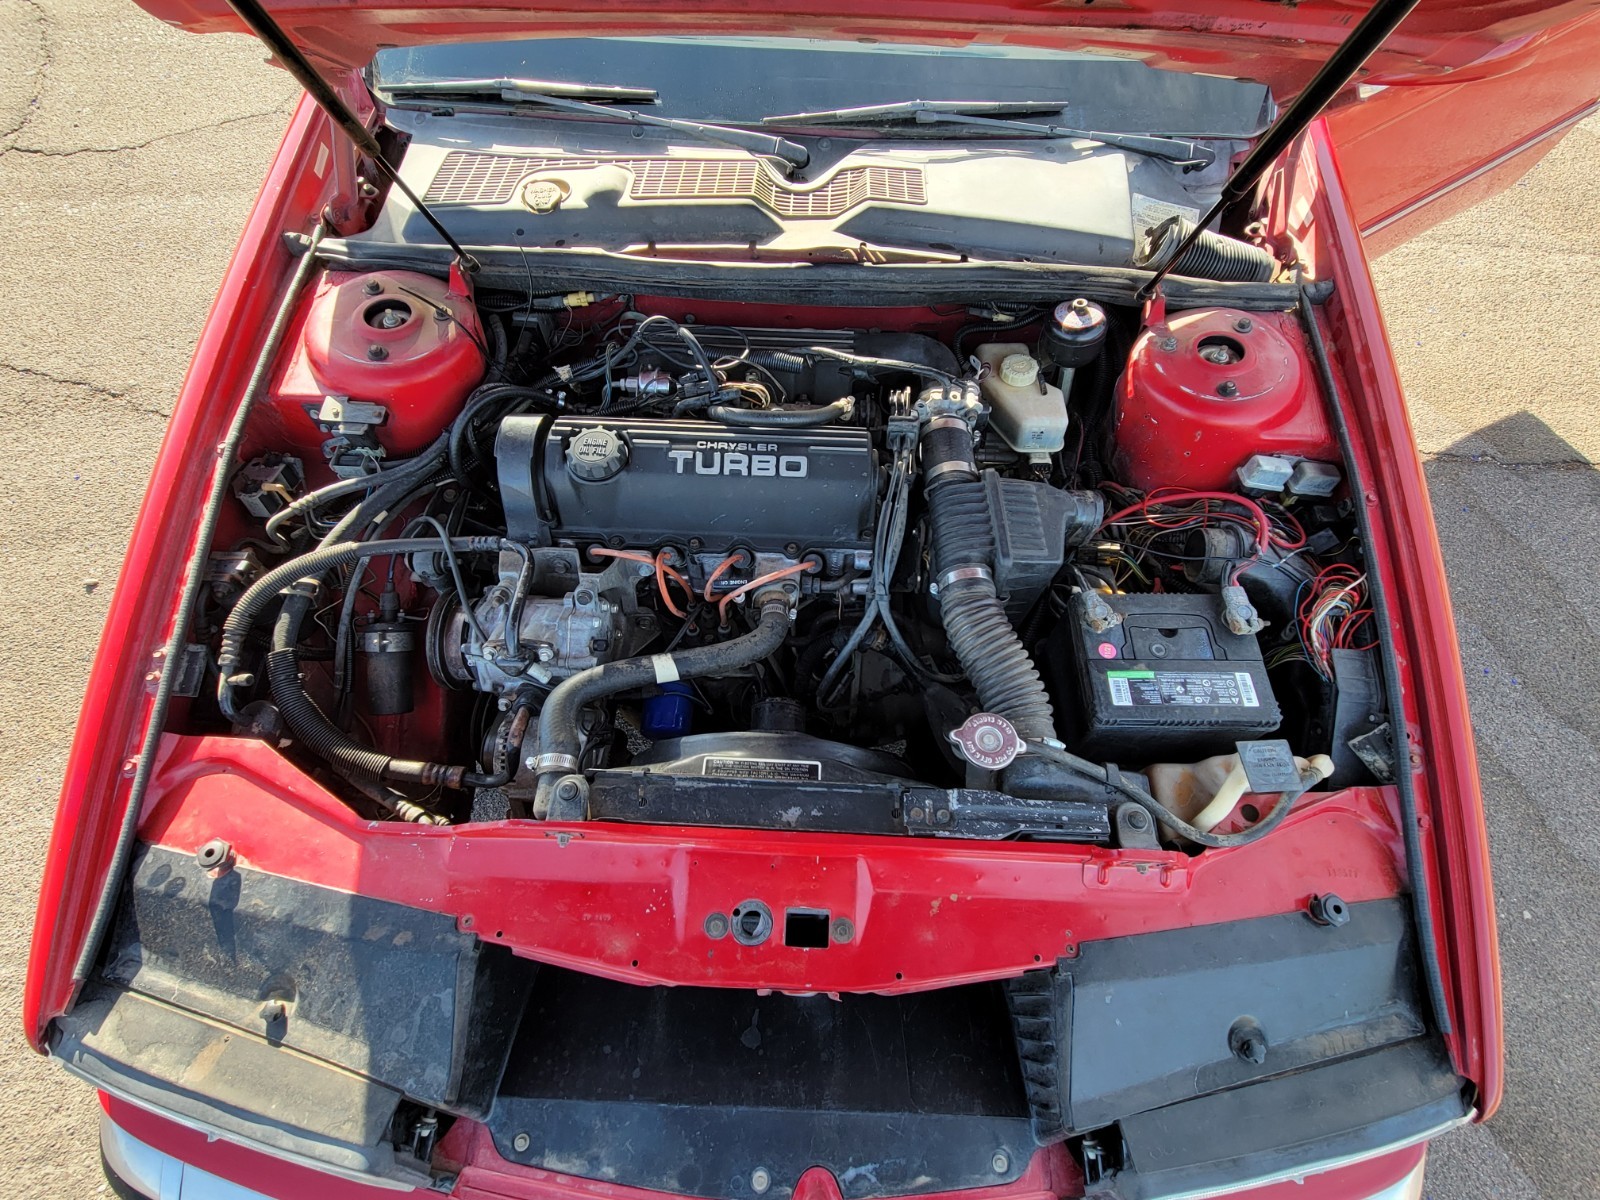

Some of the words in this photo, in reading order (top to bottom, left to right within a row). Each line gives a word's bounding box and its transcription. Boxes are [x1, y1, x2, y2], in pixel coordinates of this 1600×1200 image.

[583, 437, 608, 448] ENGINE
[696, 440, 778, 452] CHRYSLER
[578, 446, 590, 455] OIL
[592, 446, 607, 456] FILL
[668, 450, 808, 478] TURBO
